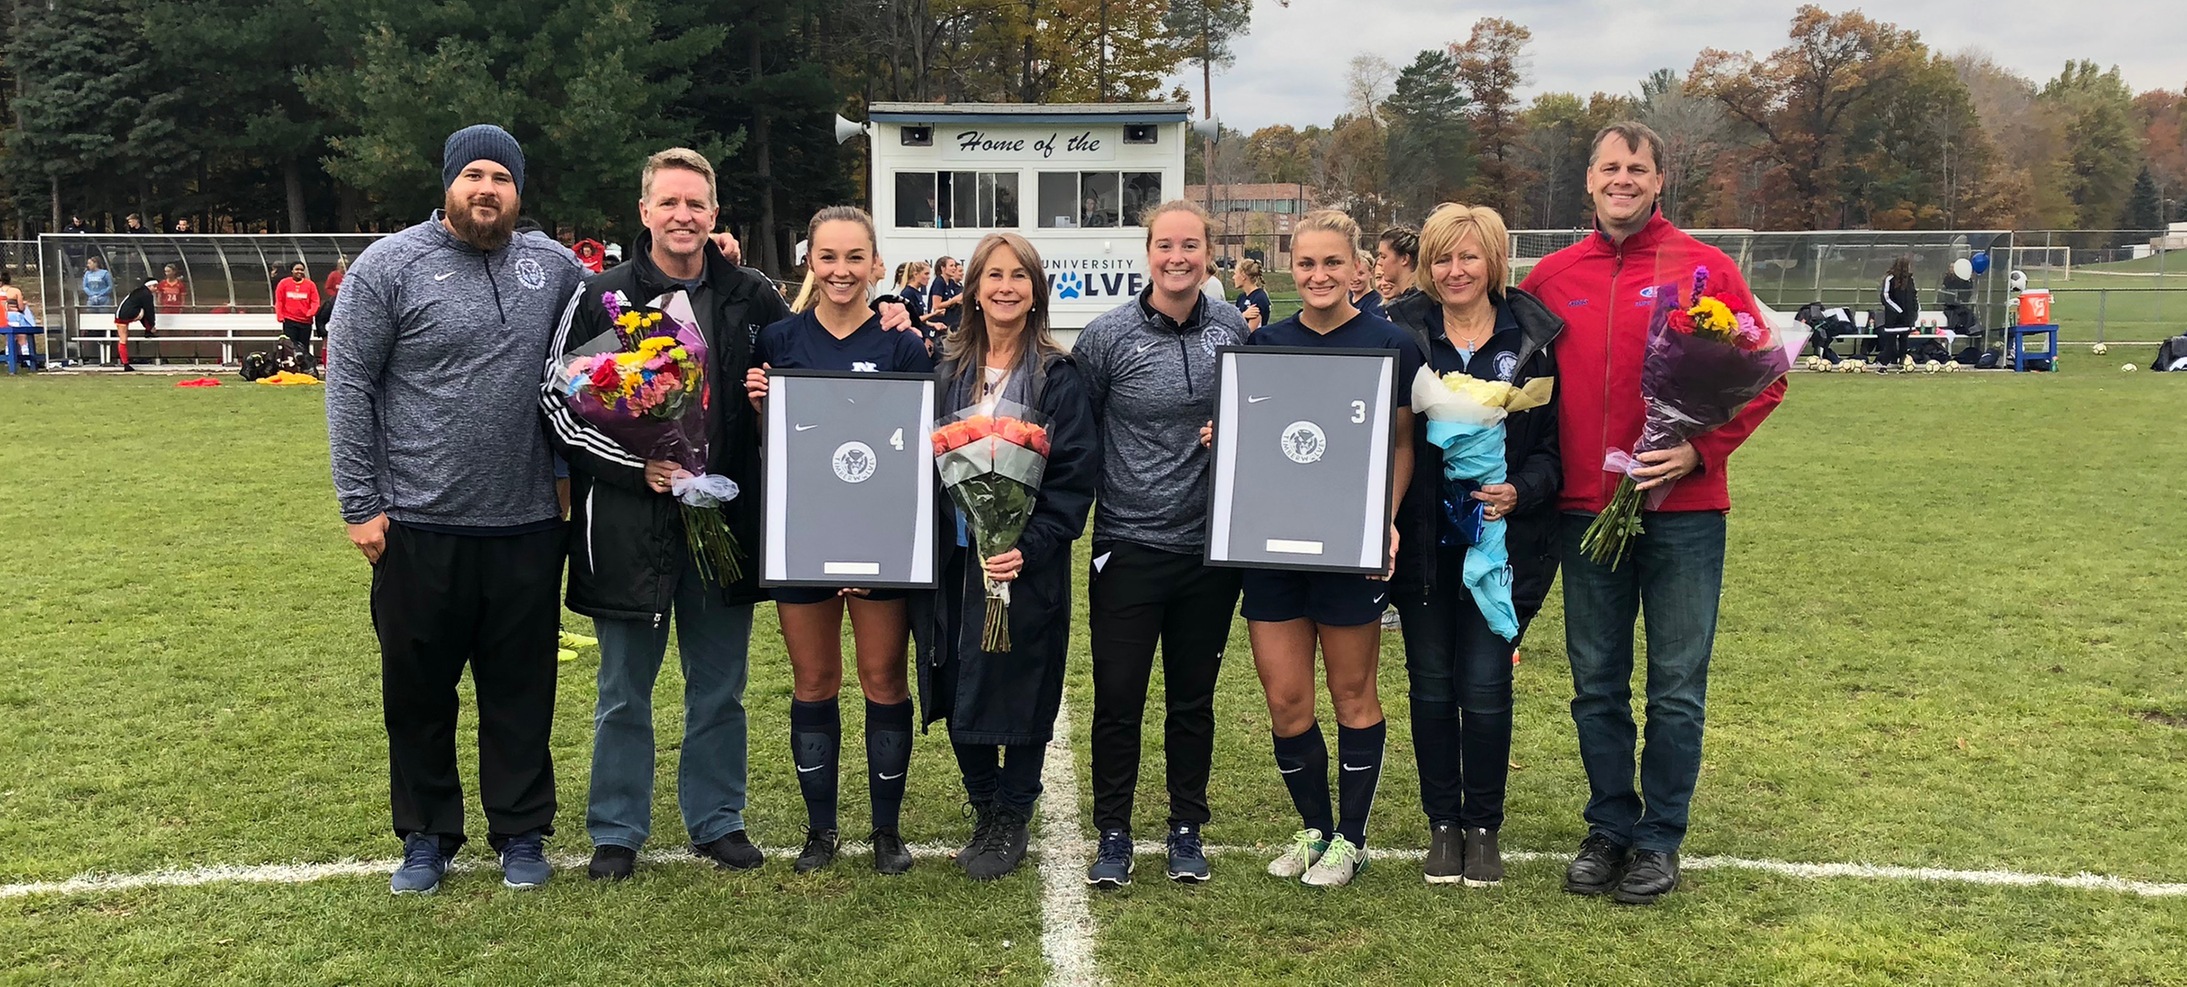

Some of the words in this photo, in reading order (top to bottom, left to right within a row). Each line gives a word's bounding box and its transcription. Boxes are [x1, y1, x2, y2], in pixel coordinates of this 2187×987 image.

[957, 131, 1024, 152] Home
[1033, 132, 1057, 158] of
[1067, 131, 1100, 152] the
[1042, 259, 1134, 269] UNIVERSITY
[1351, 400, 1366, 424] 3
[889, 427, 904, 451] 4
